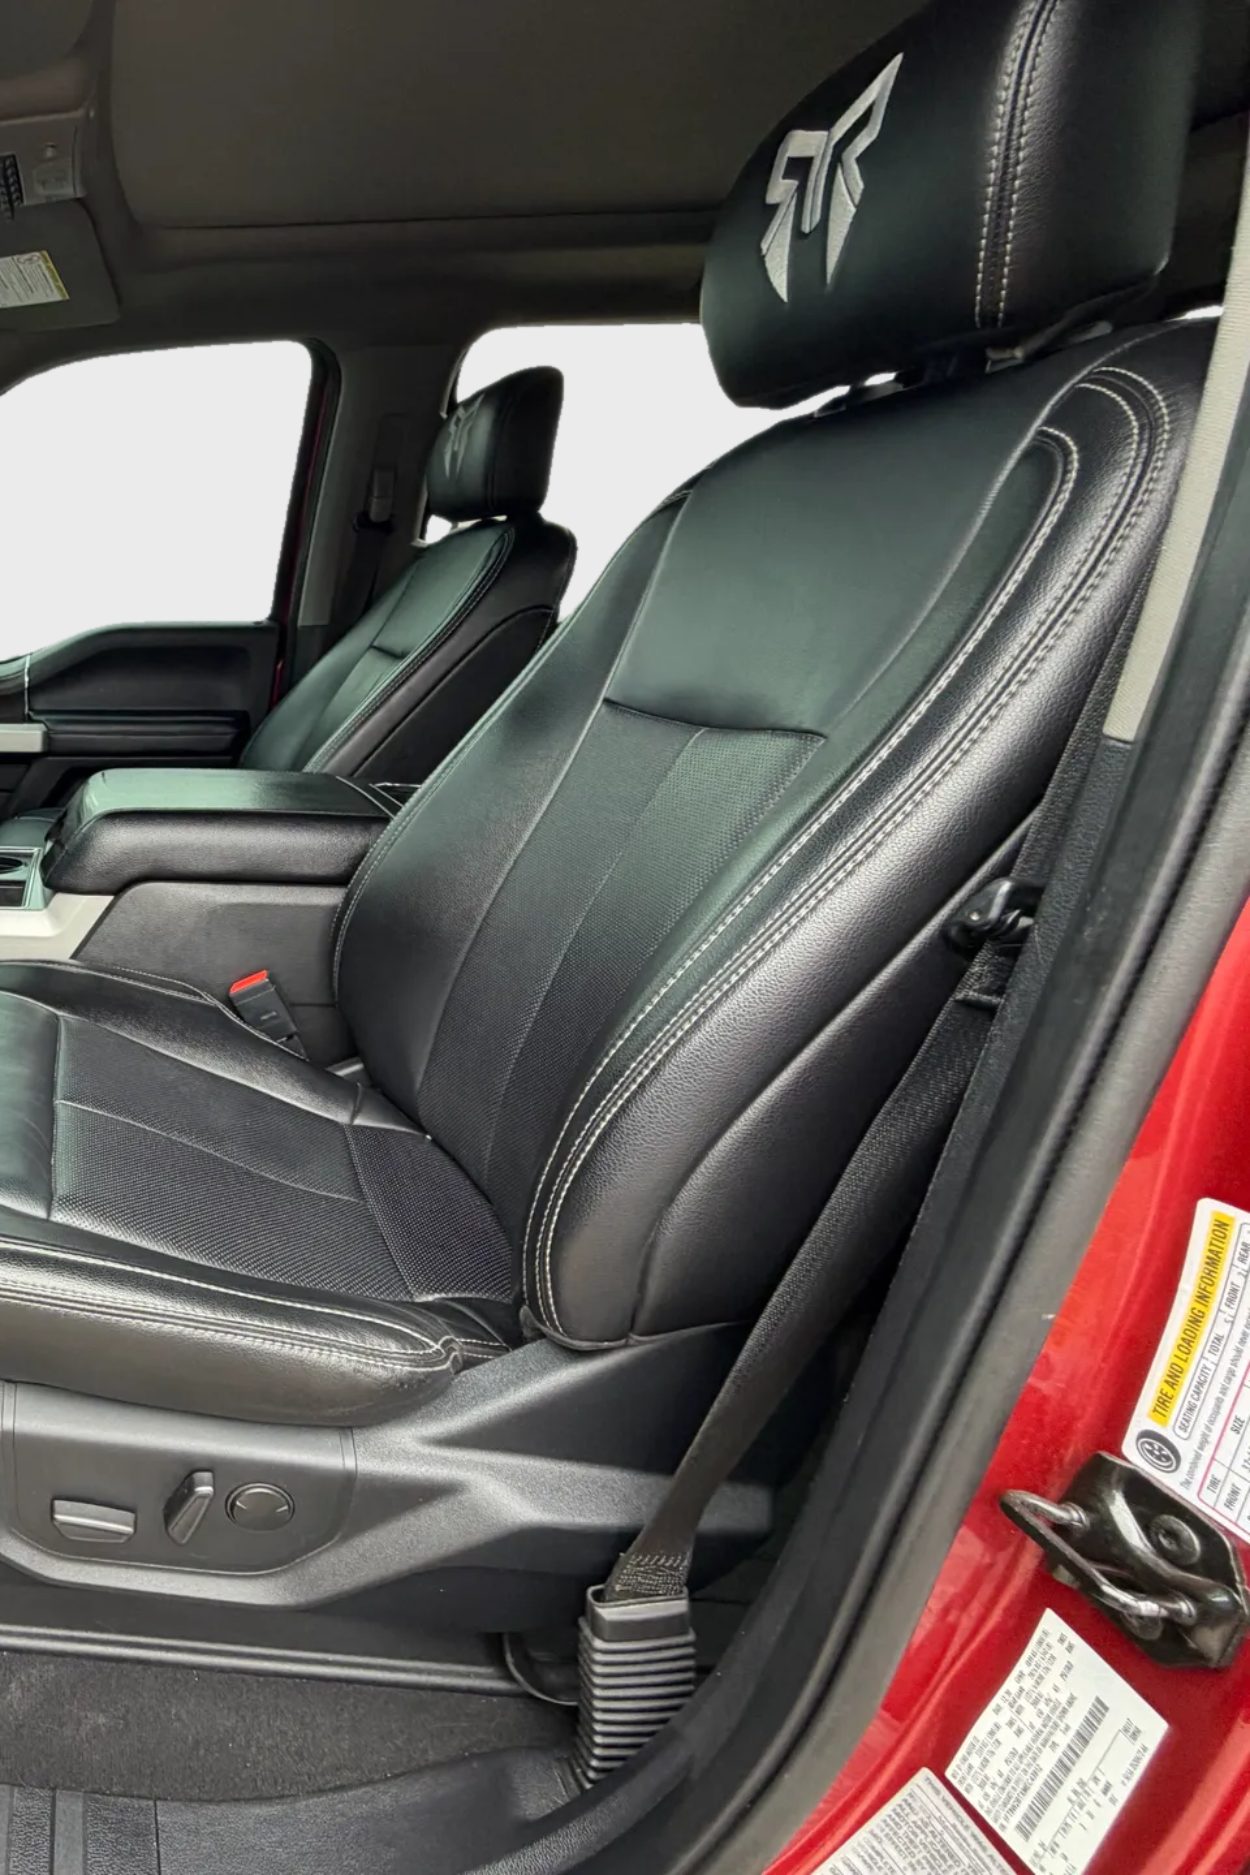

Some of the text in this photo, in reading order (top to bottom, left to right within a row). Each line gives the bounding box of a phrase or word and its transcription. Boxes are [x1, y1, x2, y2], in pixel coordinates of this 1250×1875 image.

[1237, 1242, 1250, 1264] REAR
[1224, 1281, 1241, 1310] FRONT
[1152, 1219, 1230, 1418] TIRE AND LOADING INFORMATION
[1207, 1333, 1225, 1357] TOTAL
[1178, 1363, 1212, 1432] SEATING CAPACITY
[1230, 1414, 1245, 1435] SIZE
[1206, 1473, 1221, 1494] TIRE
[1223, 1483, 1242, 1511] FRONT
